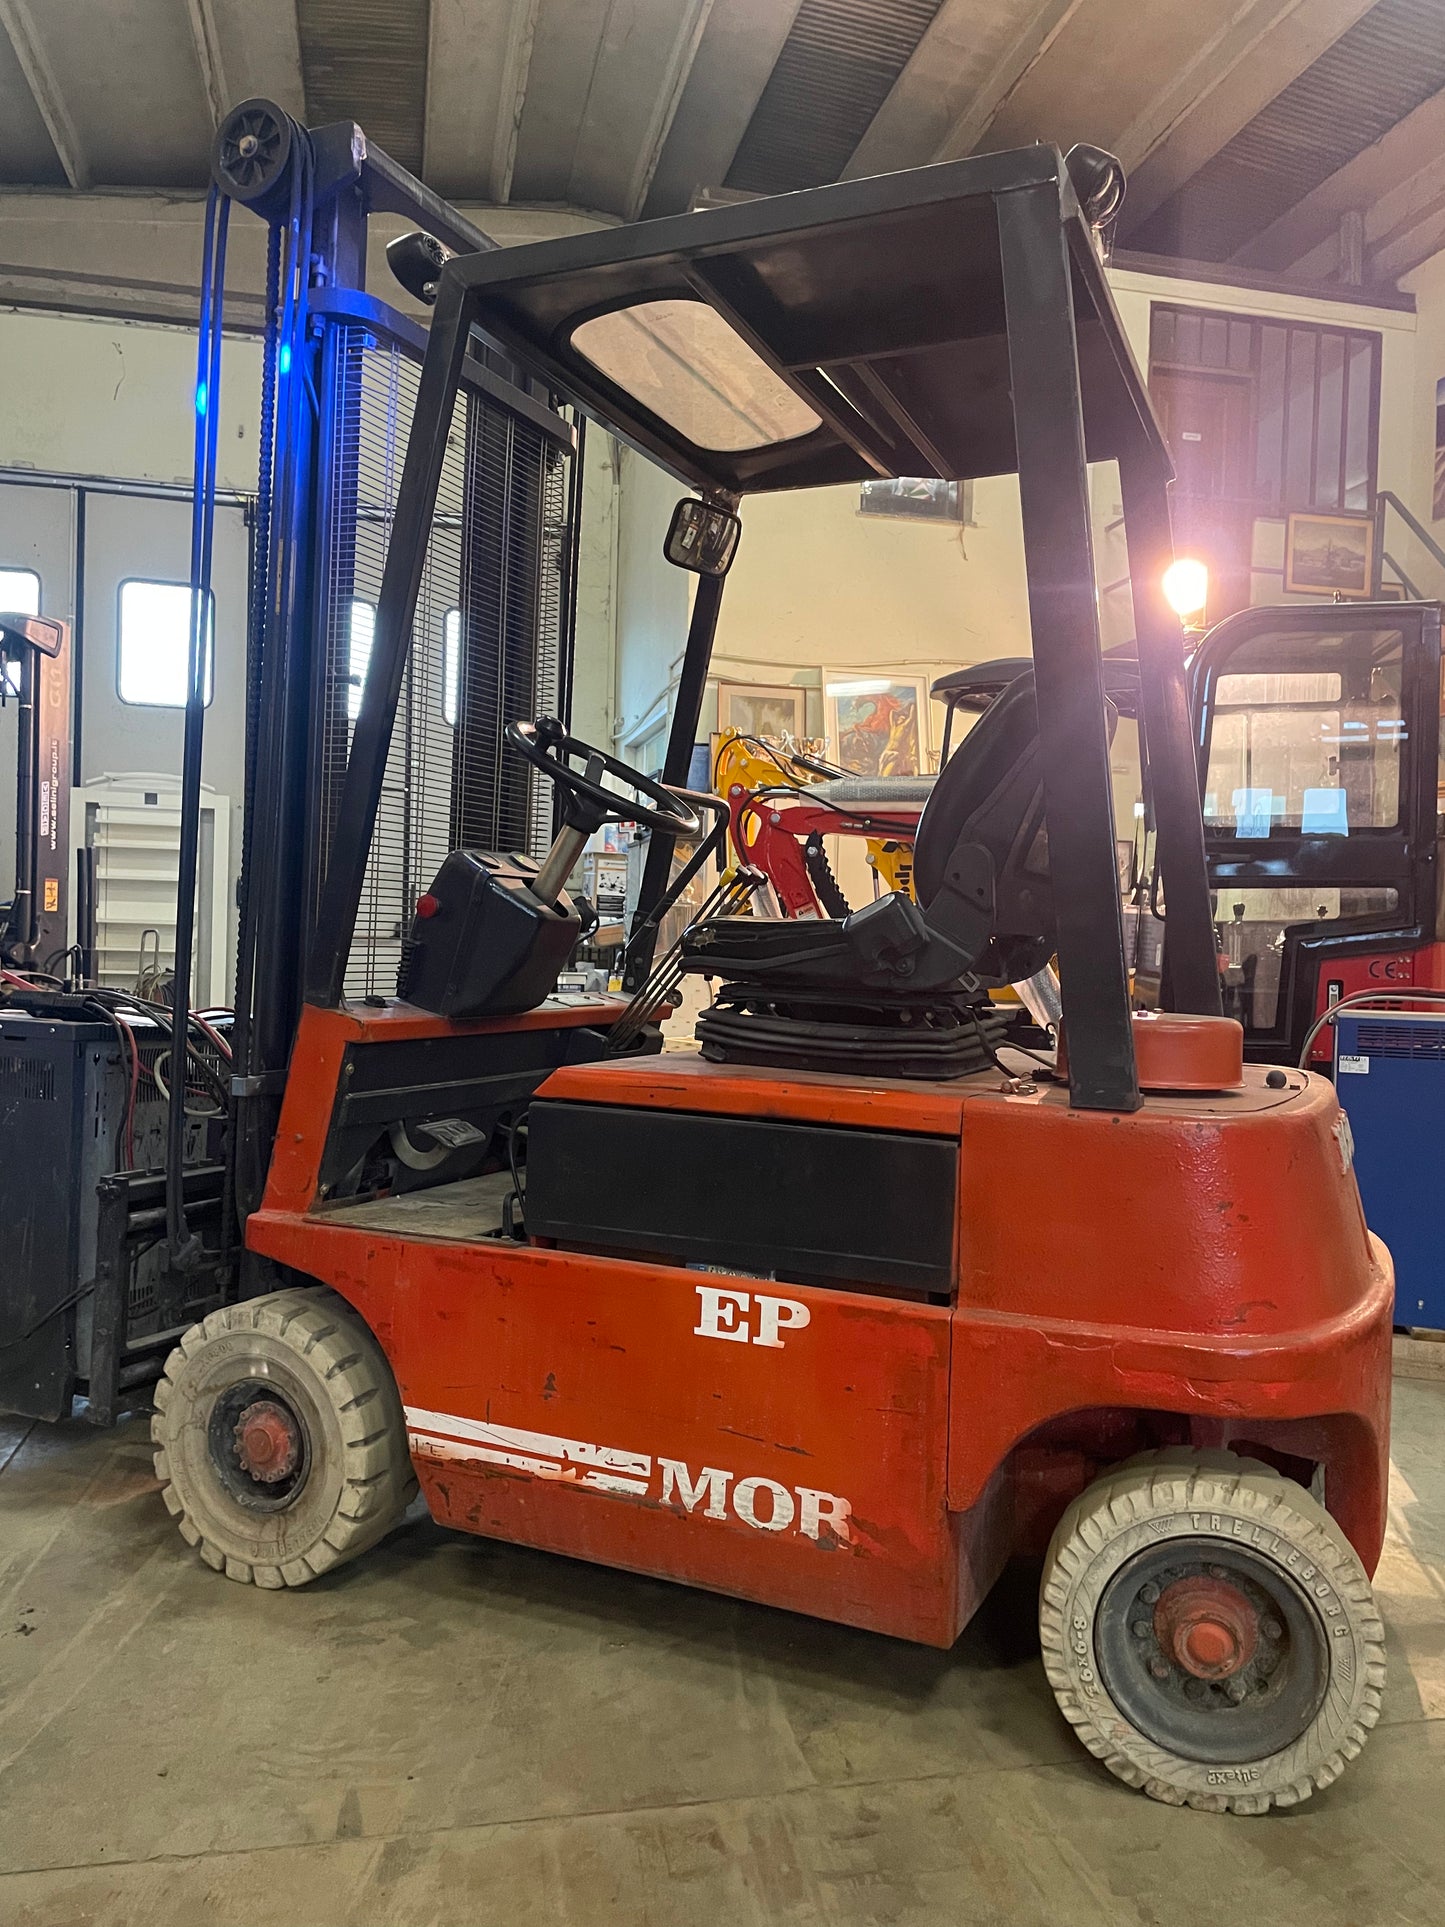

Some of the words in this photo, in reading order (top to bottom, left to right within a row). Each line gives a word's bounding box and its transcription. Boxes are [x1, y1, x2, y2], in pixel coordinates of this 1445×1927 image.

[1369, 960, 1397, 979] CE
[693, 1286, 811, 1349] EP
[657, 1457, 854, 1550] MOR
[1189, 1512, 1350, 1639] TRELLEBORG
